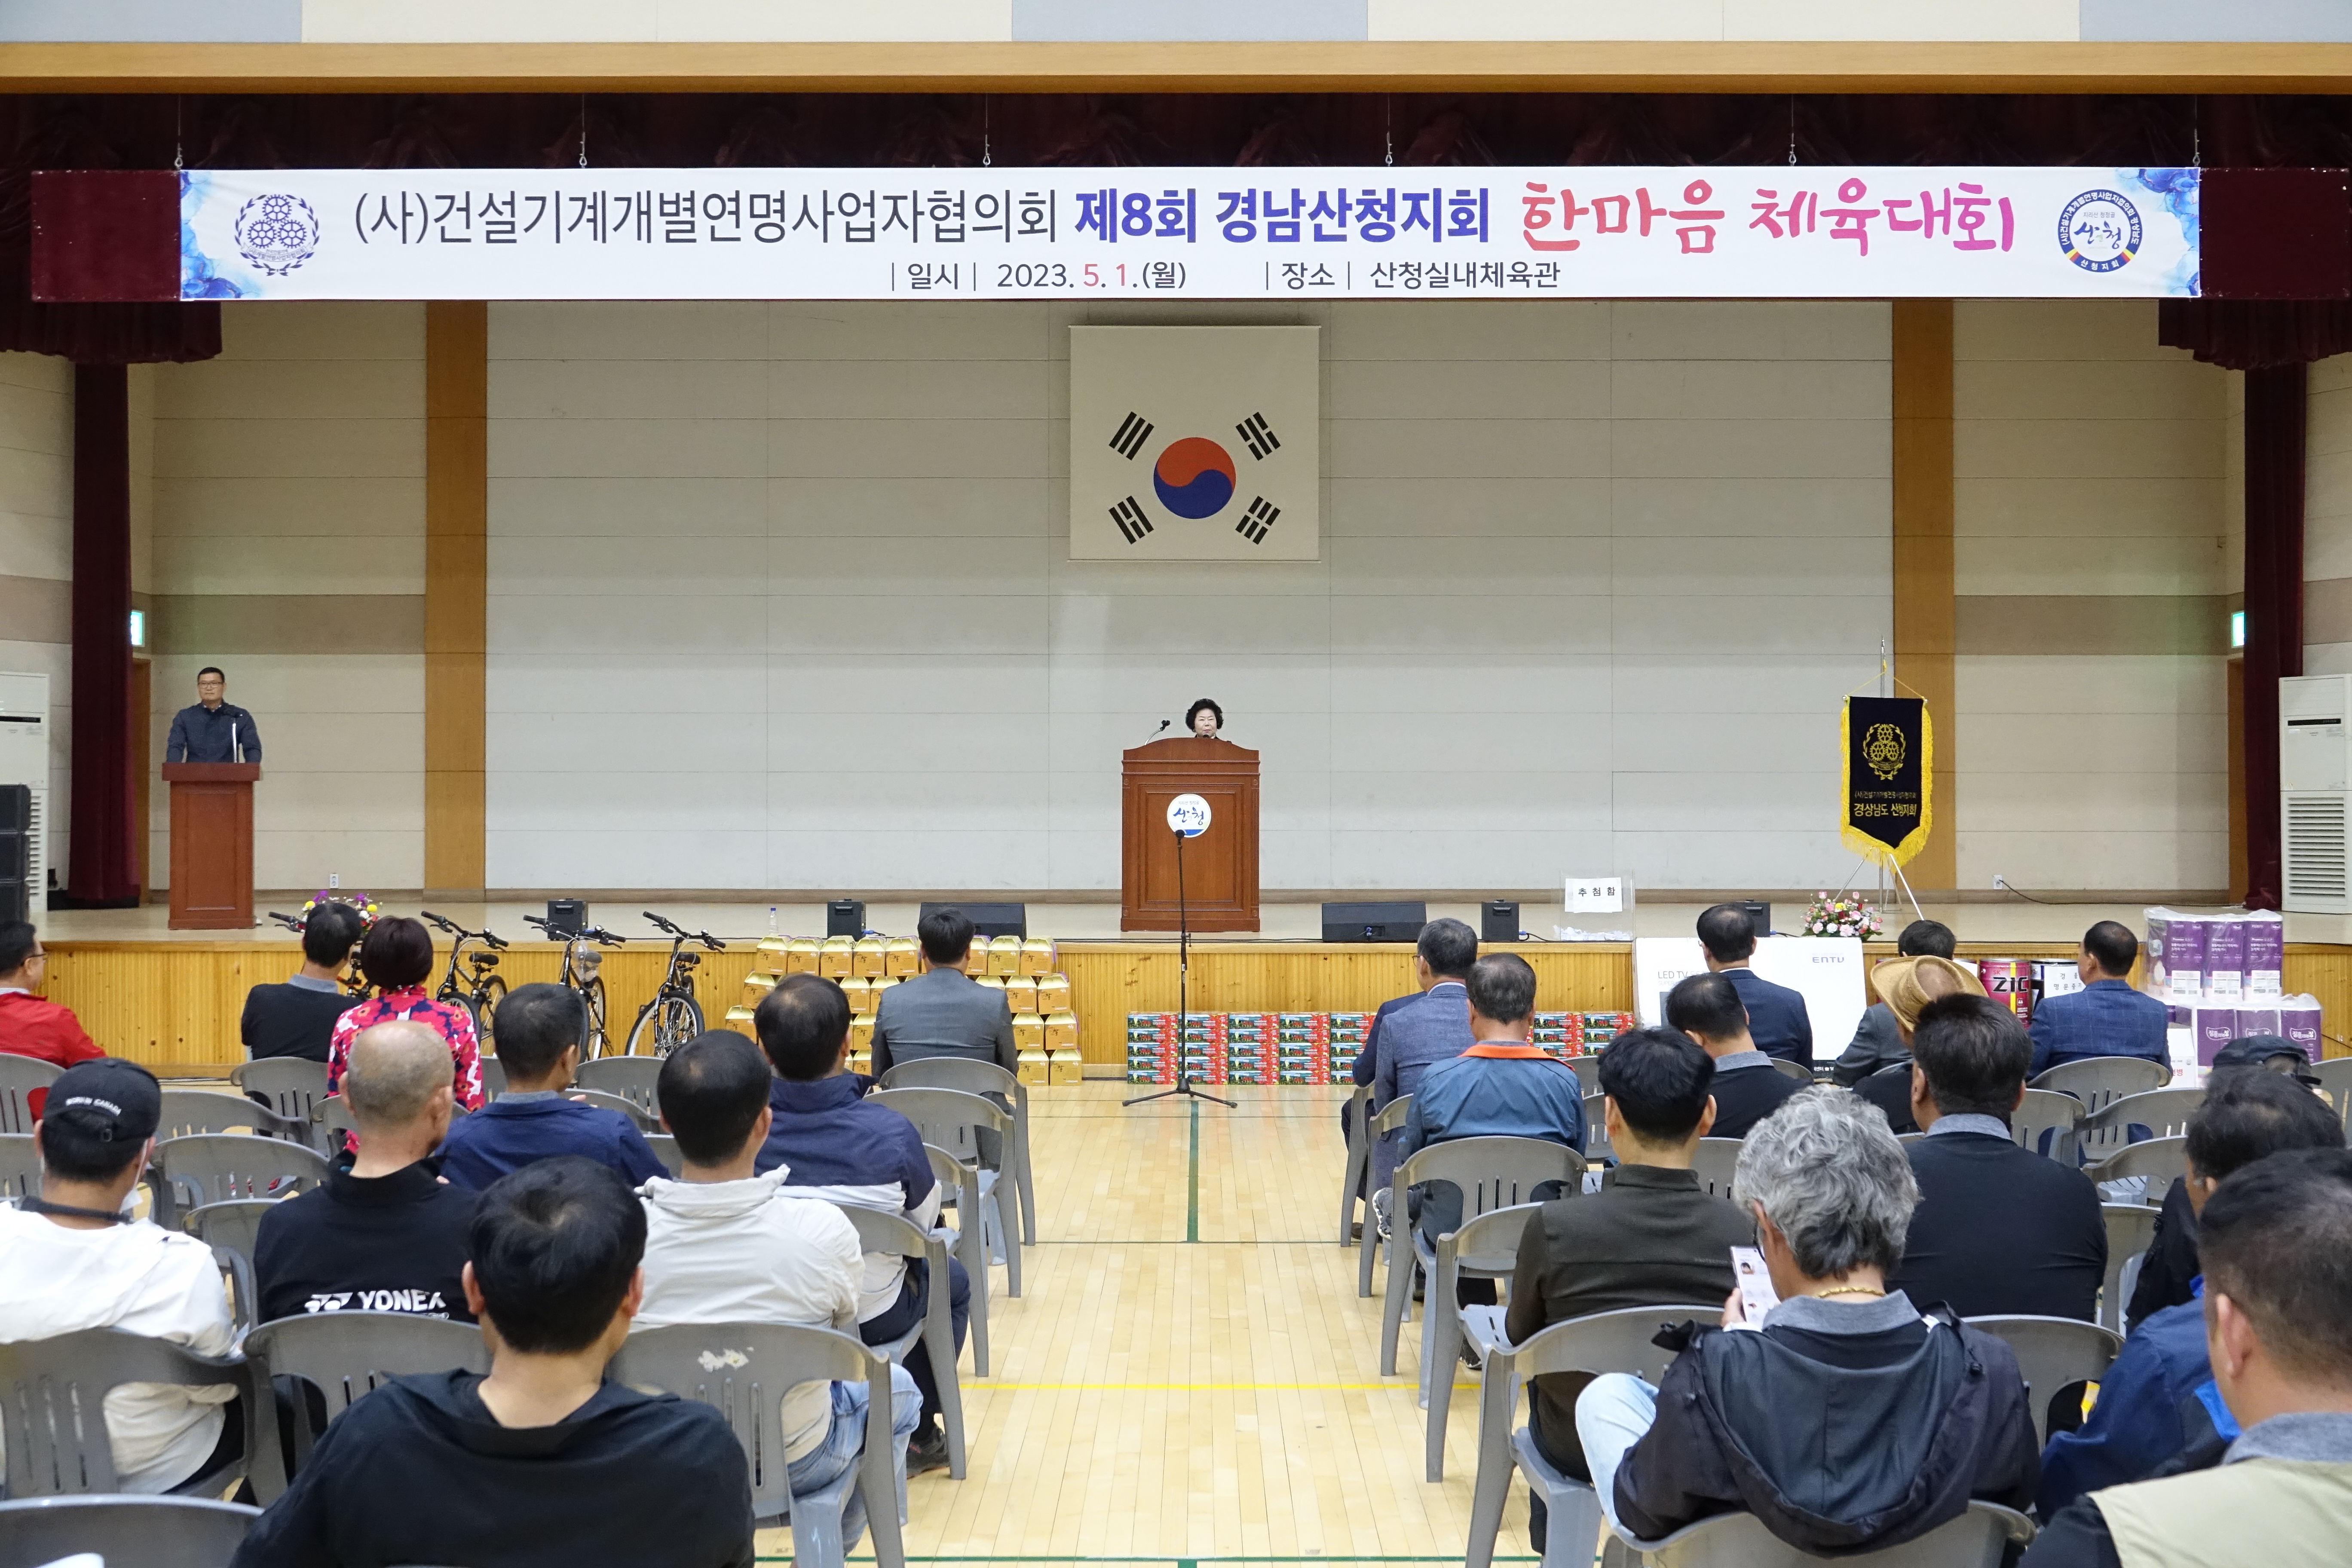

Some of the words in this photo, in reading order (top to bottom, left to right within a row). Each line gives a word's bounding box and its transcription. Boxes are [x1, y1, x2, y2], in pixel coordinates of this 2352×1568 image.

[356, 190, 1055, 244] (사)건설기계개별연명사업자협의회
[1075, 188, 1196, 243] 제8회
[1216, 188, 1488, 243] 경남산청지회
[1522, 180, 1724, 254] 한마음
[1749, 178, 2014, 256] 체육대회
[998, 264, 1074, 288] 2023.
[1084, 264, 1106, 288] 5.
[1370, 262, 1560, 289] 산청실내체육관
[1854, 803, 1889, 817] 경상남도
[1891, 803, 1917, 817] 산청지회
[1992, 976, 2029, 993] ZIC
[358, 1289, 446, 1311] YONEX
